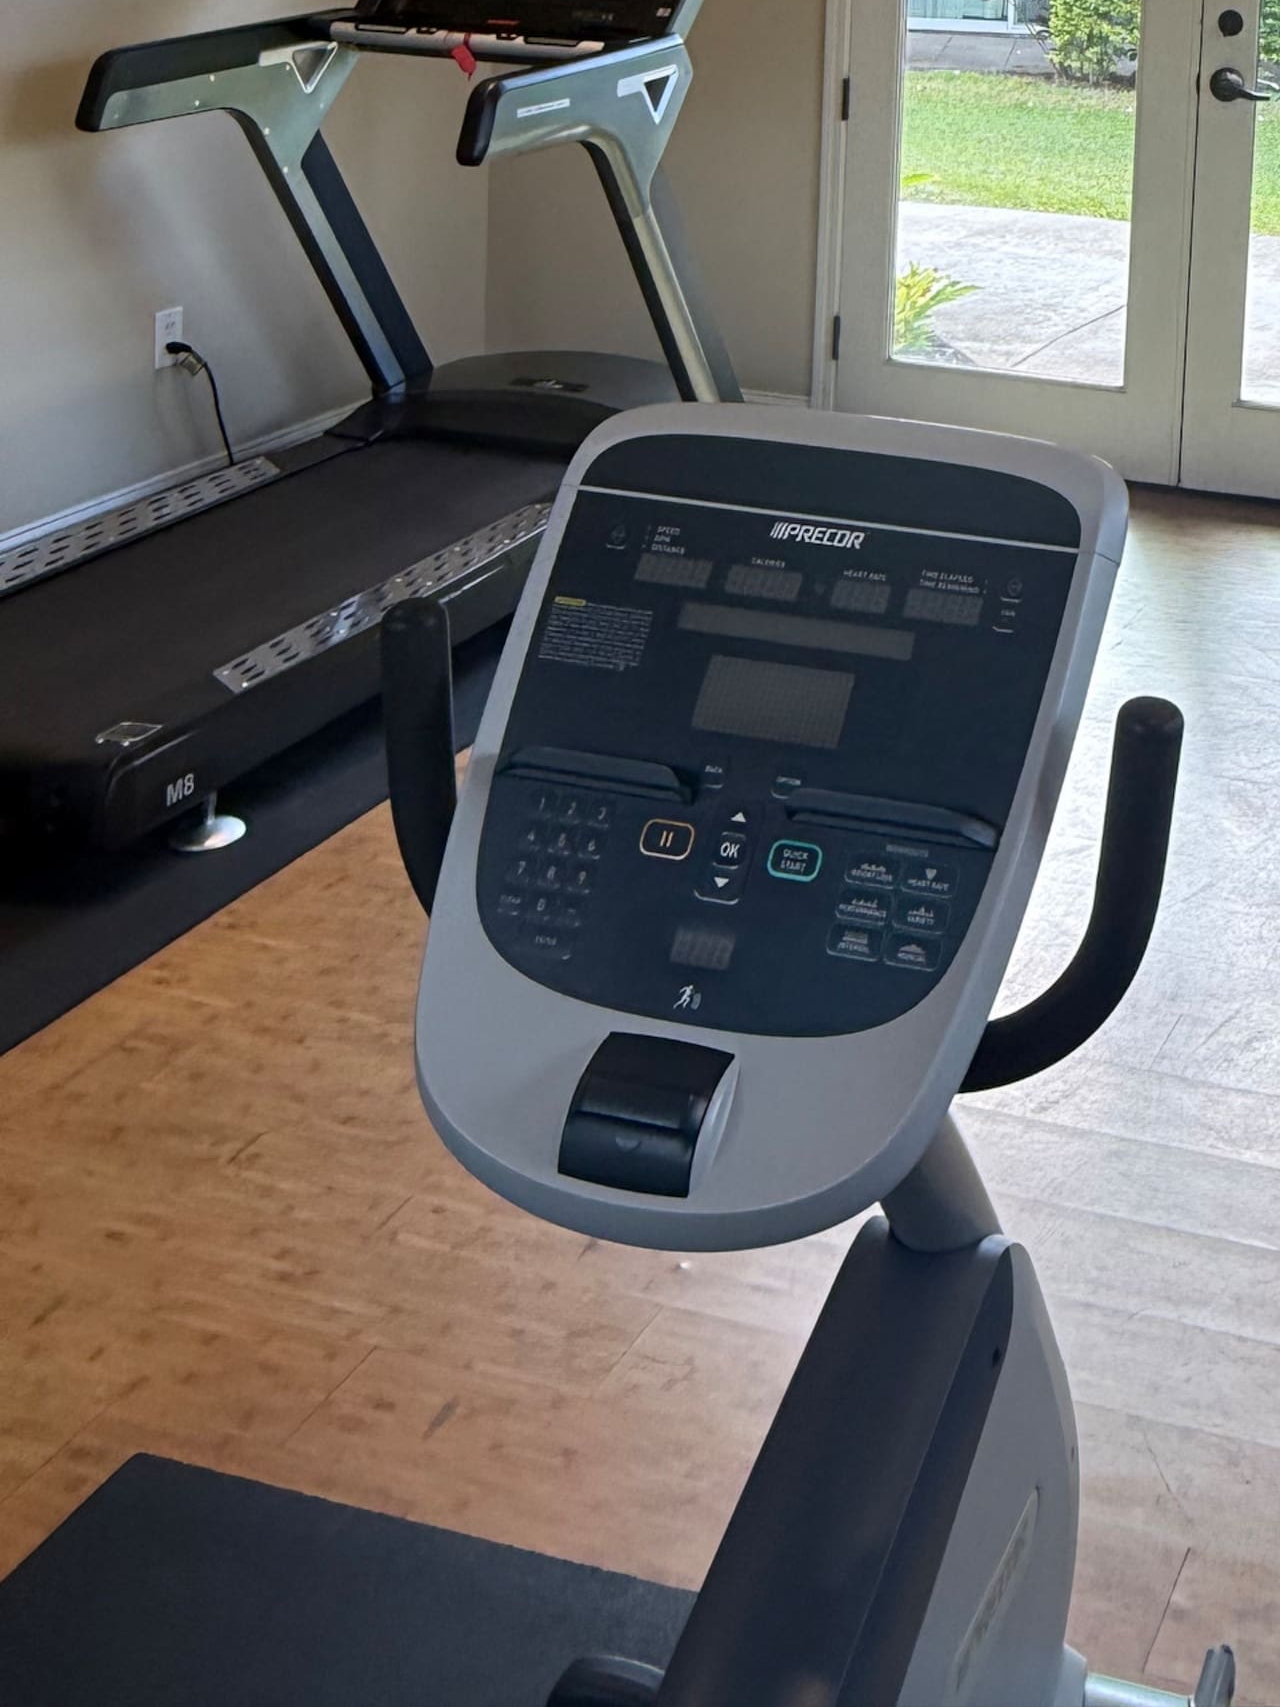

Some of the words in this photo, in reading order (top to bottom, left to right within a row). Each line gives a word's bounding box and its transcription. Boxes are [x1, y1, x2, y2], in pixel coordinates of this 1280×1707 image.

[770, 522, 866, 550] PRECOR
[166, 773, 195, 807] M8
[720, 841, 741, 859] OK
